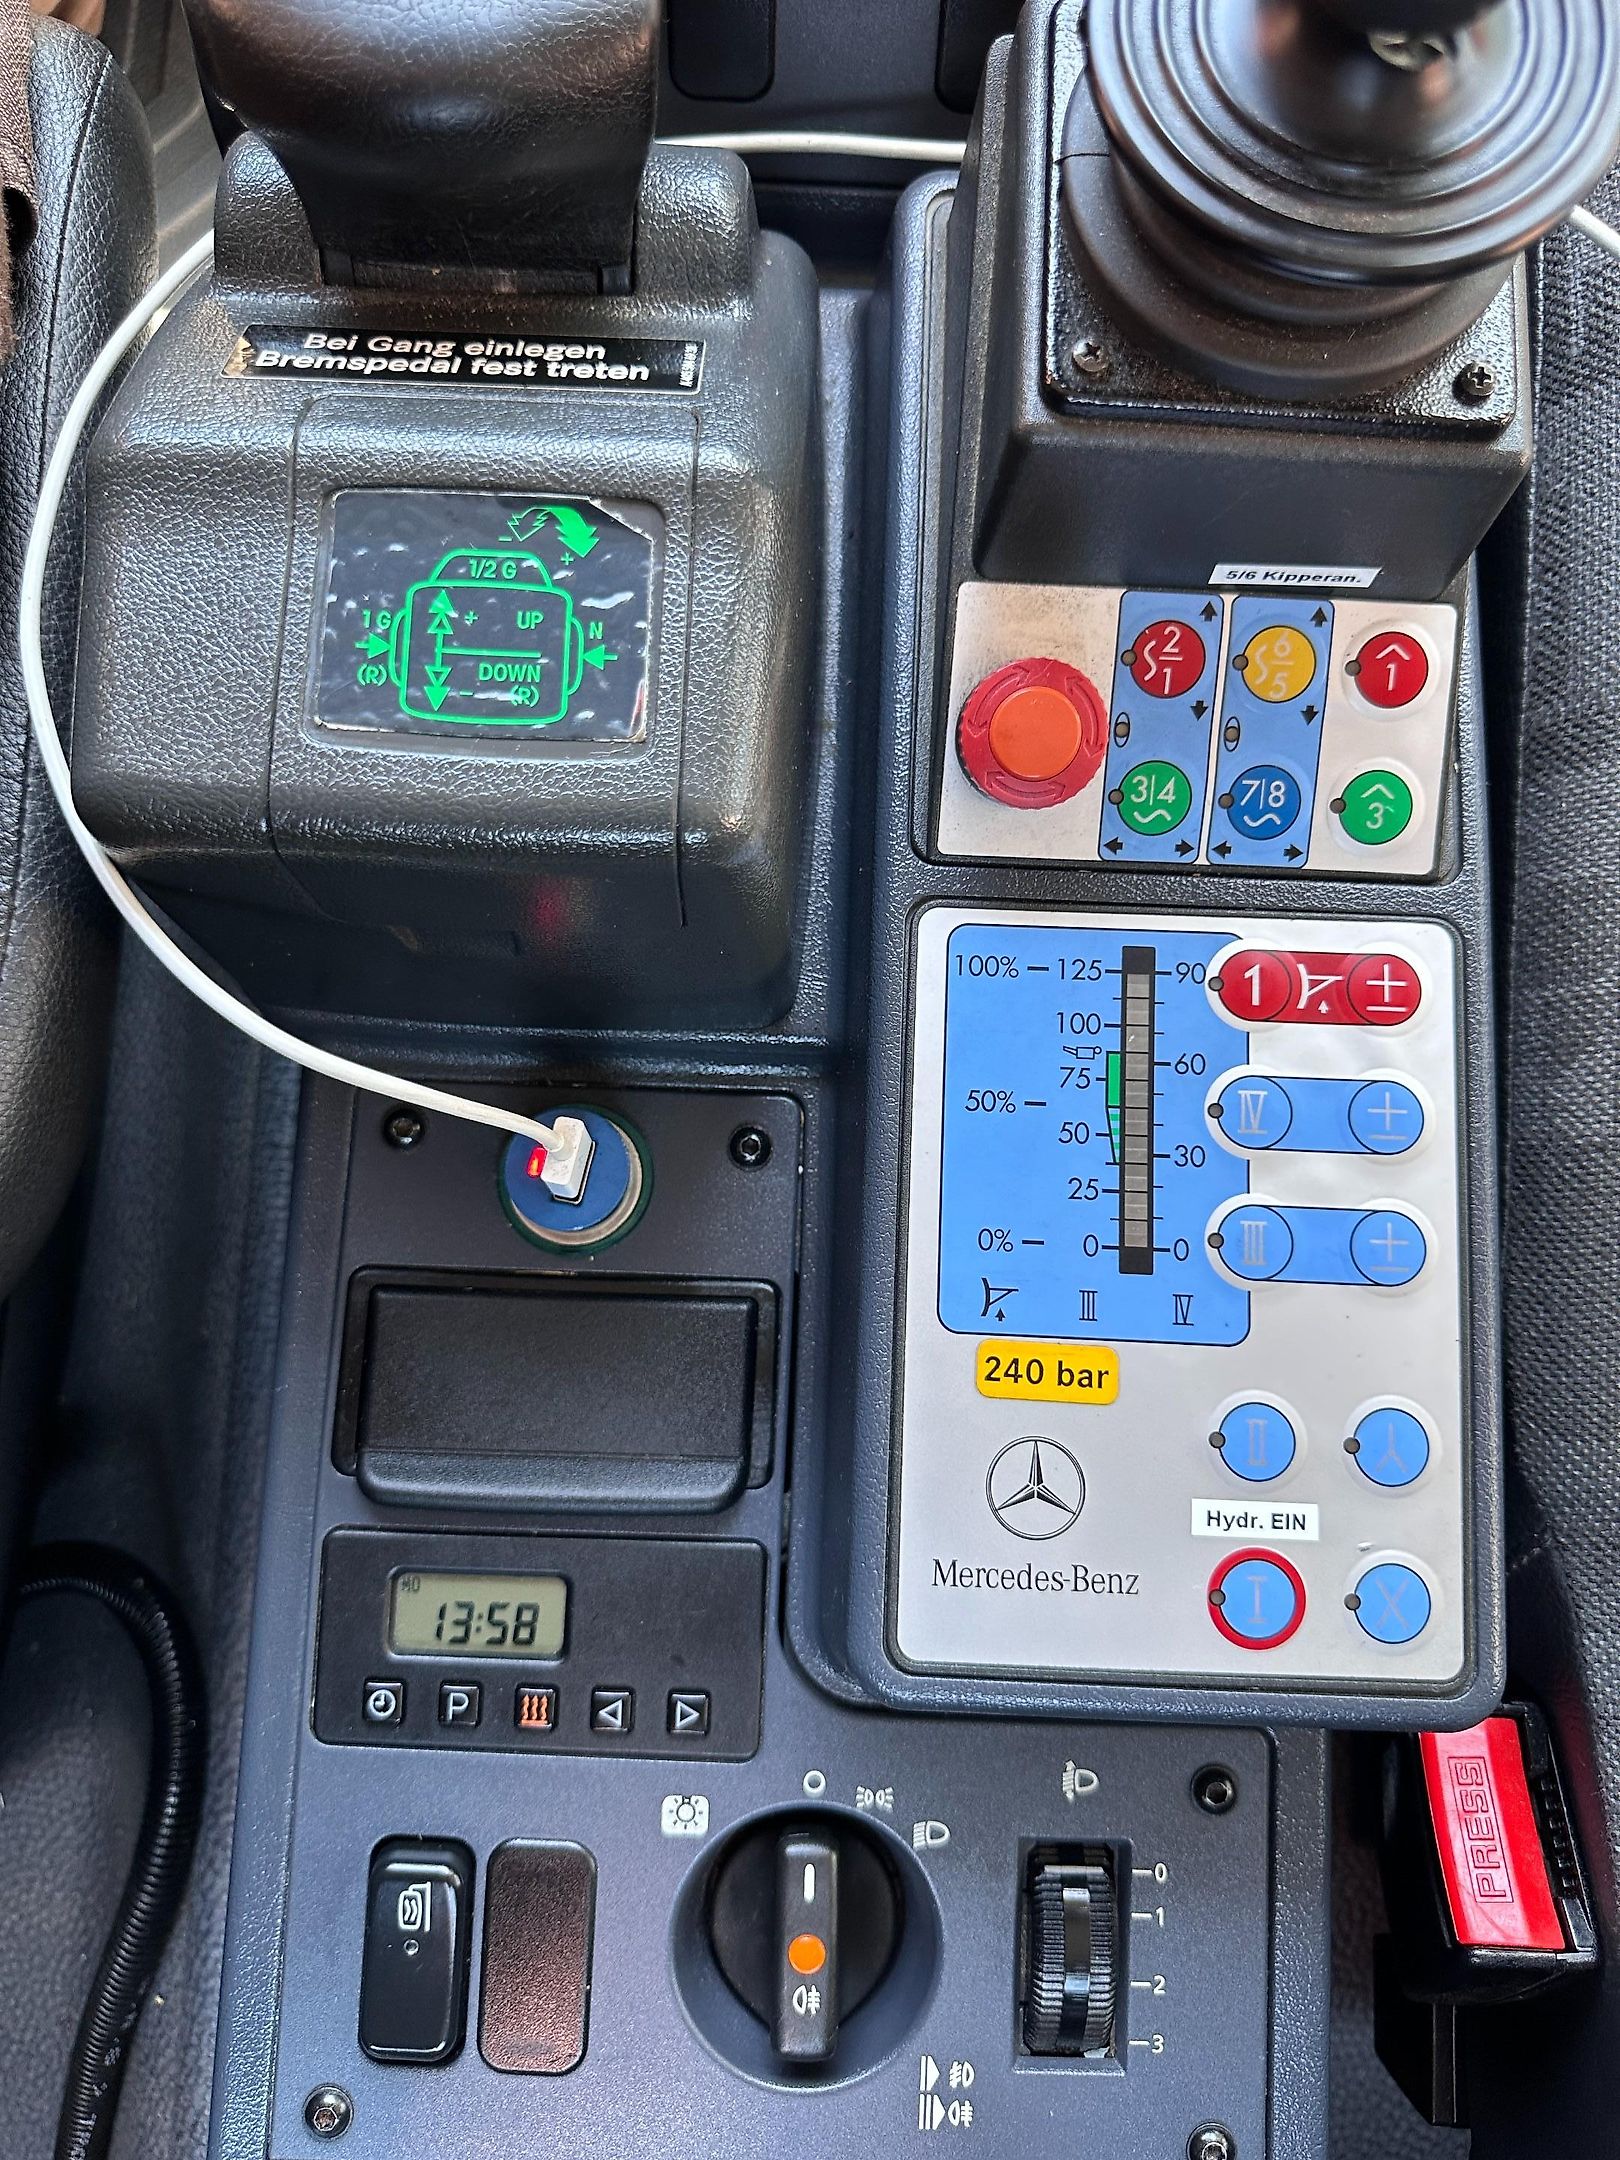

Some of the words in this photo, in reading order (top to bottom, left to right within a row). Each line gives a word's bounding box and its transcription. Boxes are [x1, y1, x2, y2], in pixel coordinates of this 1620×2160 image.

[303, 333, 359, 351] Bei
[367, 335, 456, 358] Gang
[464, 338, 607, 362] einlegen
[255, 350, 463, 375] Bremspedal
[470, 357, 539, 377] fest
[546, 360, 650, 381] treten
[468, 559, 497, 579] 1/2
[499, 561, 518, 580] G
[1225, 570, 1257, 581] 5/6
[1262, 571, 1362, 584] Kipperan.
[362, 610, 372, 628] 1
[376, 611, 391, 629] G
[517, 610, 544, 629] UP
[589, 622, 604, 640] N
[1163, 625, 1182, 652] 2
[1273, 631, 1292, 658] 6
[357, 664, 388, 686] (R)
[479, 663, 541, 682] DOWN
[1162, 667, 1174, 695] 1
[1385, 662, 1397, 692] 1
[508, 685, 539, 708] (R)
[1269, 672, 1288, 698] 5
[955, 954, 1020, 979] 100%
[1058, 958, 1103, 982] 125
[1176, 962, 1206, 984] 90
[1244, 964, 1261, 1006] 1
[1056, 1012, 1102, 1035] 100
[1174, 1053, 1206, 1076] 60
[1060, 1066, 1091, 1089] 75
[964, 1089, 1017, 1114] 50%
[1058, 1121, 1090, 1145] 50
[1174, 1145, 1206, 1168] 30
[1068, 1178, 1100, 1201] 25
[977, 1228, 1014, 1253] 0%
[1083, 1234, 1099, 1257] 0
[1173, 1238, 1190, 1261] 0
[984, 1355, 1045, 1387] 240
[1056, 1360, 1110, 1391] bar
[1206, 1509, 1264, 1533] Hydr.
[1271, 1512, 1307, 1532] EIN
[931, 1558, 1140, 1596] Mercedes-Benz
[435, 1600, 541, 1646] 13:58
[446, 1691, 469, 1722] P
[1454, 1762, 1507, 1898] PRESS
[1154, 1861, 1168, 1884] 0
[1155, 1906, 1165, 1927] 1
[1152, 1975, 1167, 1995] 2
[1151, 2034, 1165, 2054] 3
